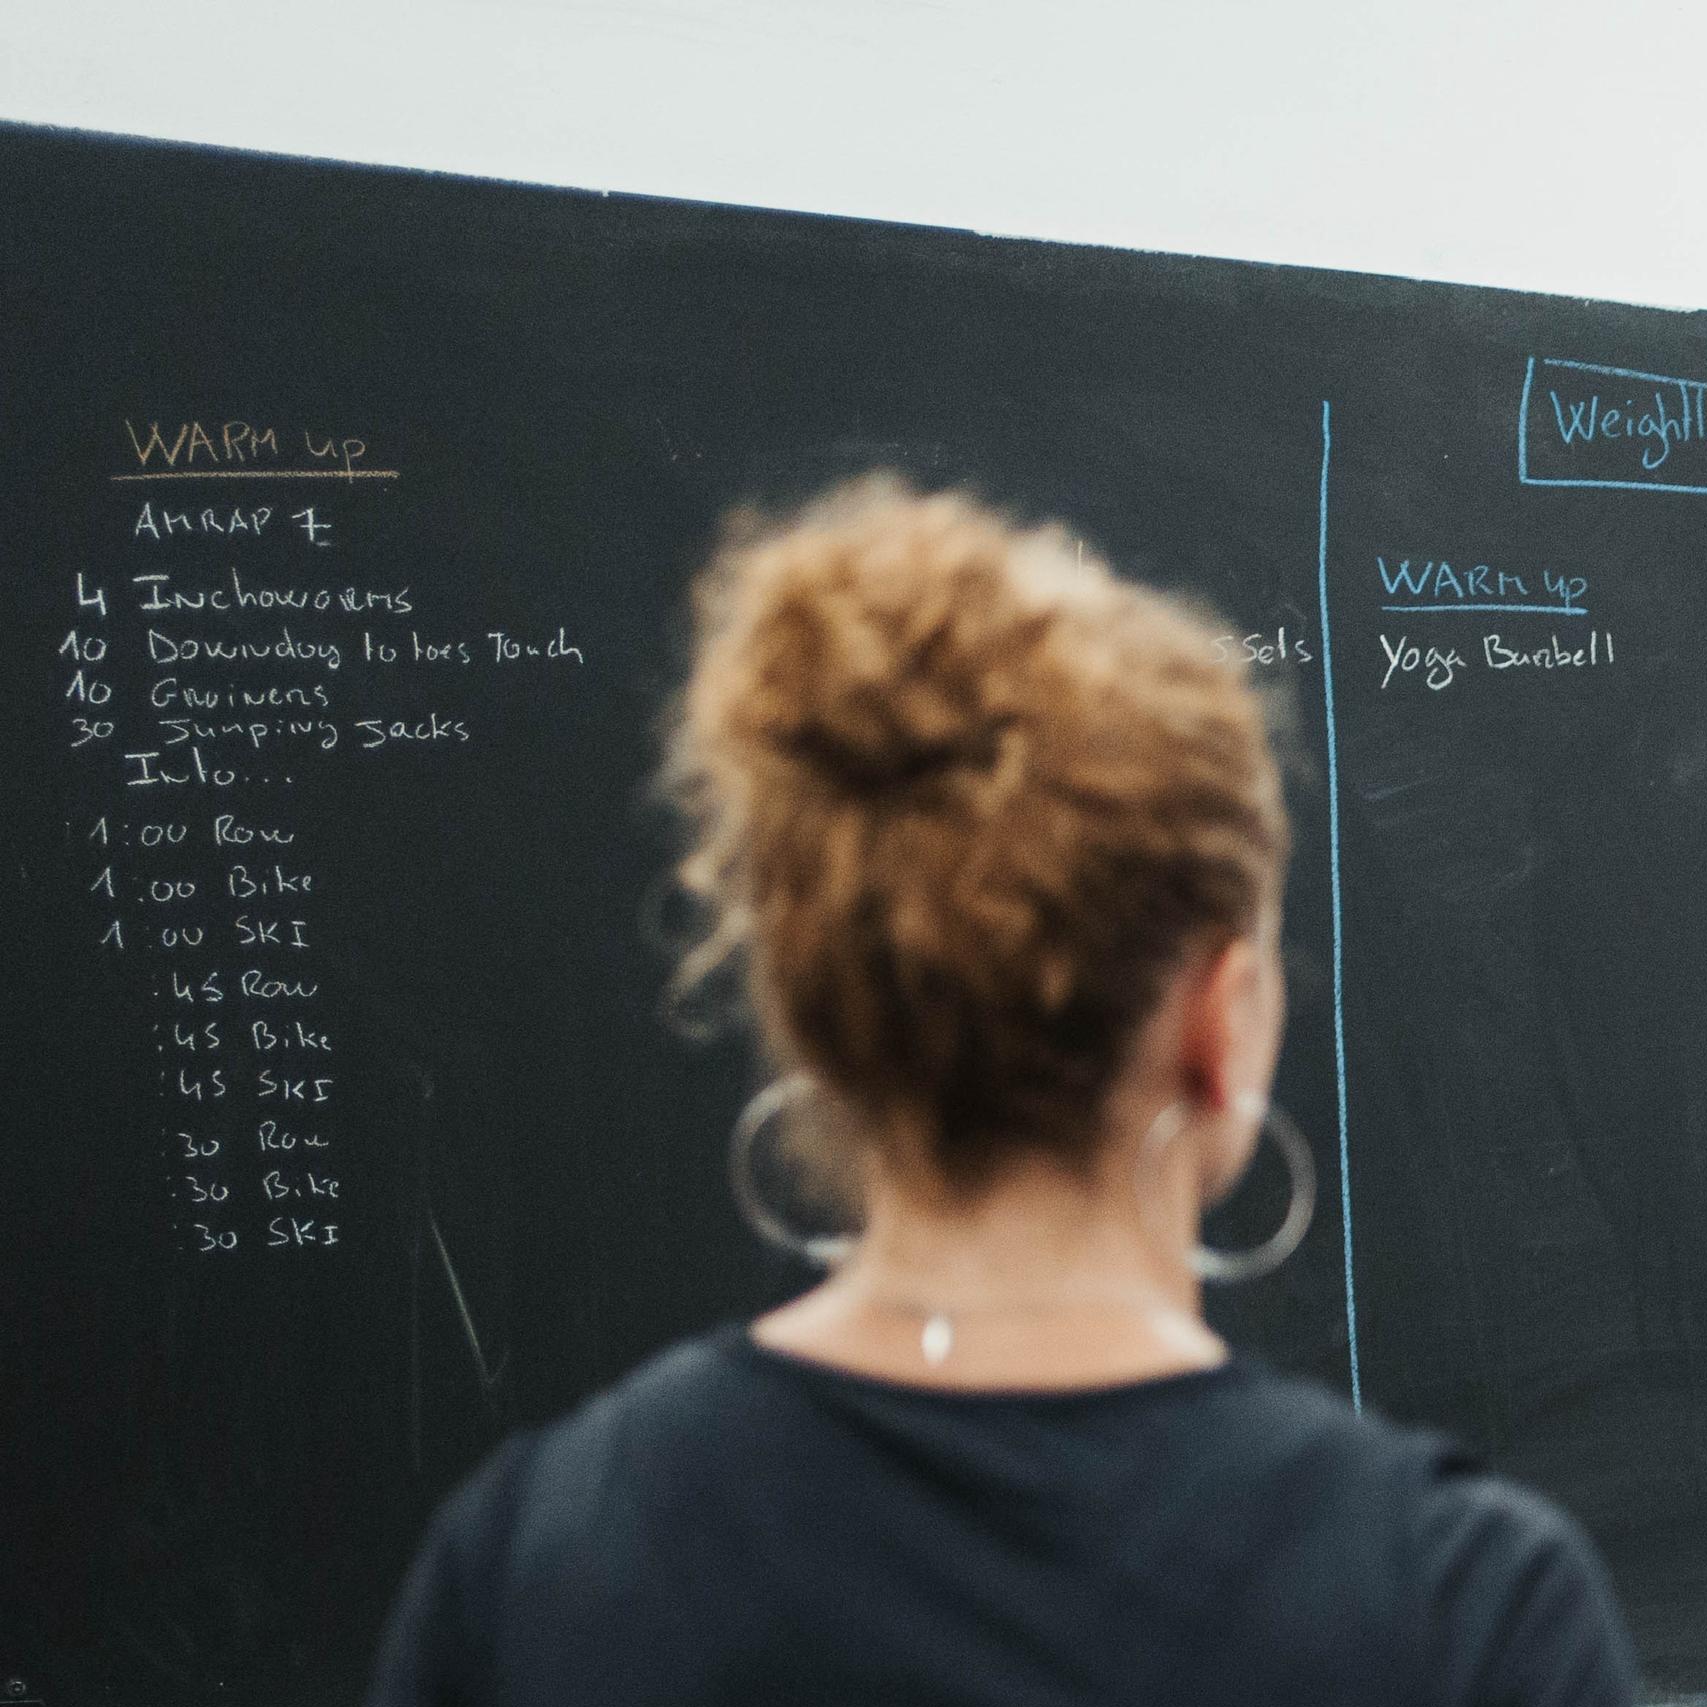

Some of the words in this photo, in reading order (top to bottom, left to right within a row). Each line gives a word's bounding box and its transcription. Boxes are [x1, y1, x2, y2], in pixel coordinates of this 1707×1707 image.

[135, 503, 272, 541] AMRAP
[76, 572, 107, 615] 4
[58, 629, 107, 661] 10
[364, 631, 398, 662] to
[487, 627, 584, 665] Touch
[1381, 634, 1465, 691] Yoga
[1484, 633, 1616, 670] Barbell
[65, 671, 112, 706] 10
[71, 720, 115, 747] 30
[90, 817, 188, 847] 1:00
[214, 815, 294, 844] Row
[90, 867, 195, 902] 1:00
[229, 866, 313, 898] Bike
[241, 969, 318, 998] Row
[252, 1021, 332, 1052] Bike
[259, 1121, 330, 1150] Row
[263, 1171, 341, 1200] Bike
